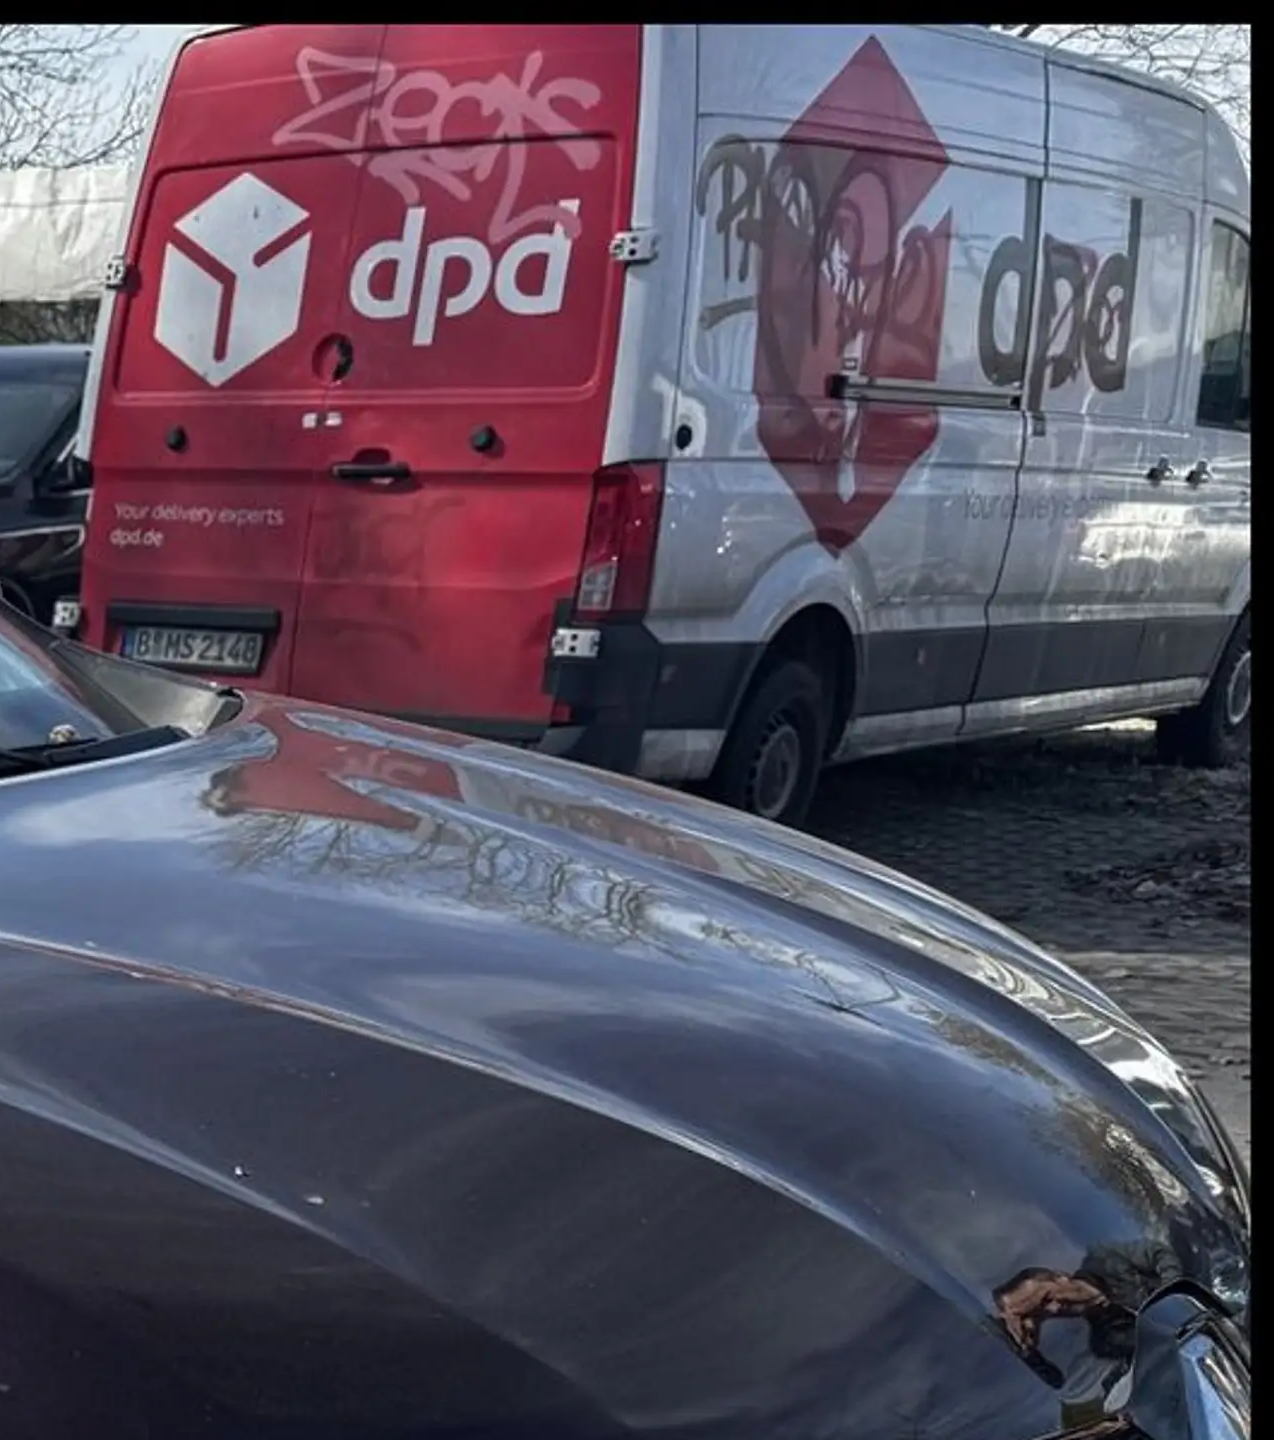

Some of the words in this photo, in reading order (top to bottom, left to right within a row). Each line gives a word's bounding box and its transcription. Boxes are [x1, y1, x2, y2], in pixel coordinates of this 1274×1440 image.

[351, 198, 580, 346] dpd
[978, 176, 1143, 415] dpd
[115, 503, 149, 520] Your
[152, 504, 215, 527] delivery
[218, 508, 285, 526] experts
[109, 529, 164, 547] dpd.de
[136, 629, 151, 657] B
